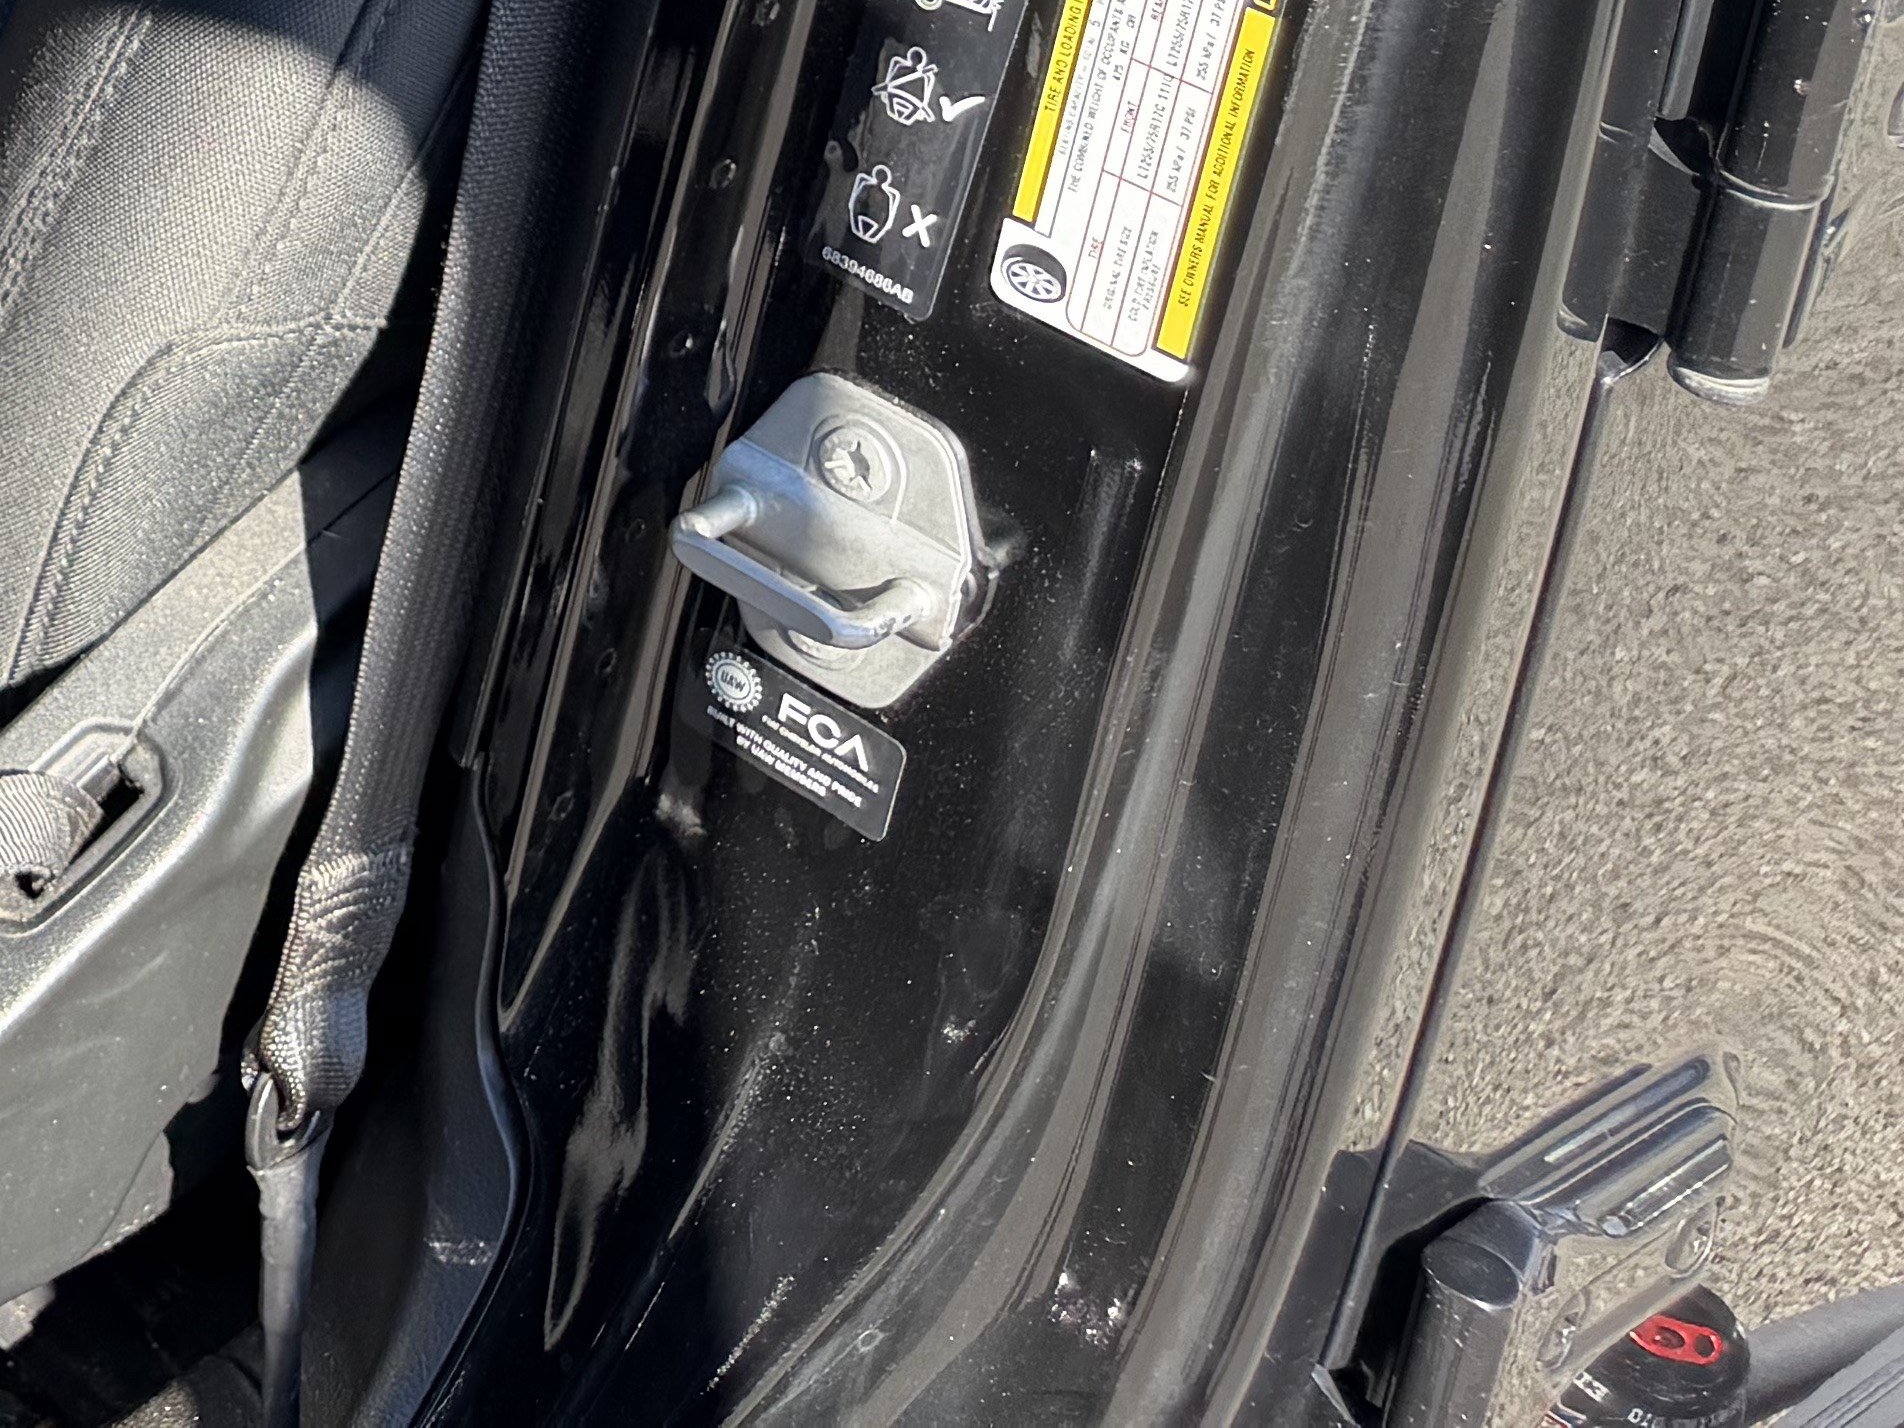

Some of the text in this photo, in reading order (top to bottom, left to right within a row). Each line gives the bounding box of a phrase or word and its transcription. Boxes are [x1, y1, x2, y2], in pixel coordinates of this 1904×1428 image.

[1058, 4, 1082, 57] LOADING
[1044, 85, 1061, 114] TIRE
[1051, 58, 1068, 84] AND
[1194, 202, 1215, 244] MANUAL
[1205, 178, 1221, 201] FOR
[1227, 48, 1256, 118] INFORMATION
[720, 670, 869, 772] UAW FCA
[707, 705, 862, 808] BUILT WITH QUALITY AND PRIDE
[736, 735, 826, 796] BY UAW MEMBERS
[779, 726, 821, 756] CHRYSLER
[822, 753, 879, 793] AUTOMOBILES
